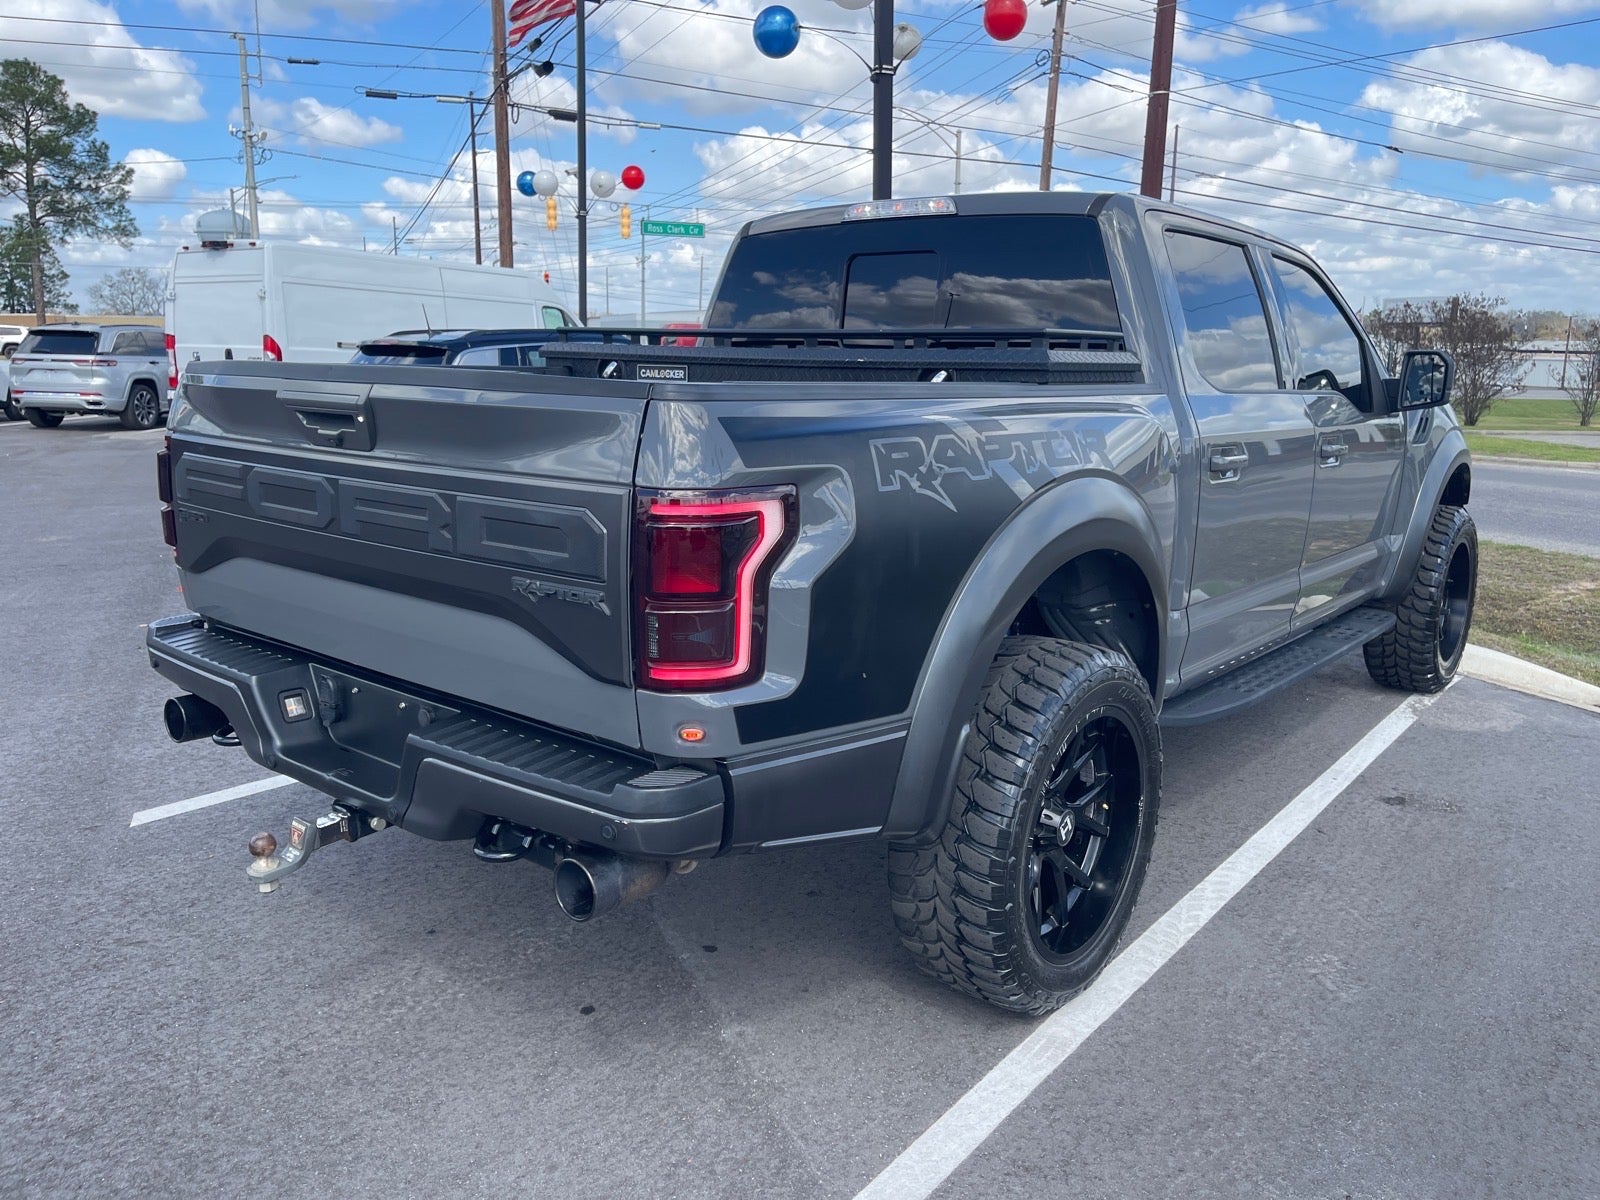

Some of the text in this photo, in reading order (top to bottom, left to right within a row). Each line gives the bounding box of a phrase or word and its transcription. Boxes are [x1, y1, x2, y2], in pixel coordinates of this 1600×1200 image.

[647, 223, 699, 235] Ross Clark Cir
[640, 368, 685, 379] CAMLOCKER
[868, 428, 1114, 513] RAPTOR
[175, 452, 608, 584] FORD
